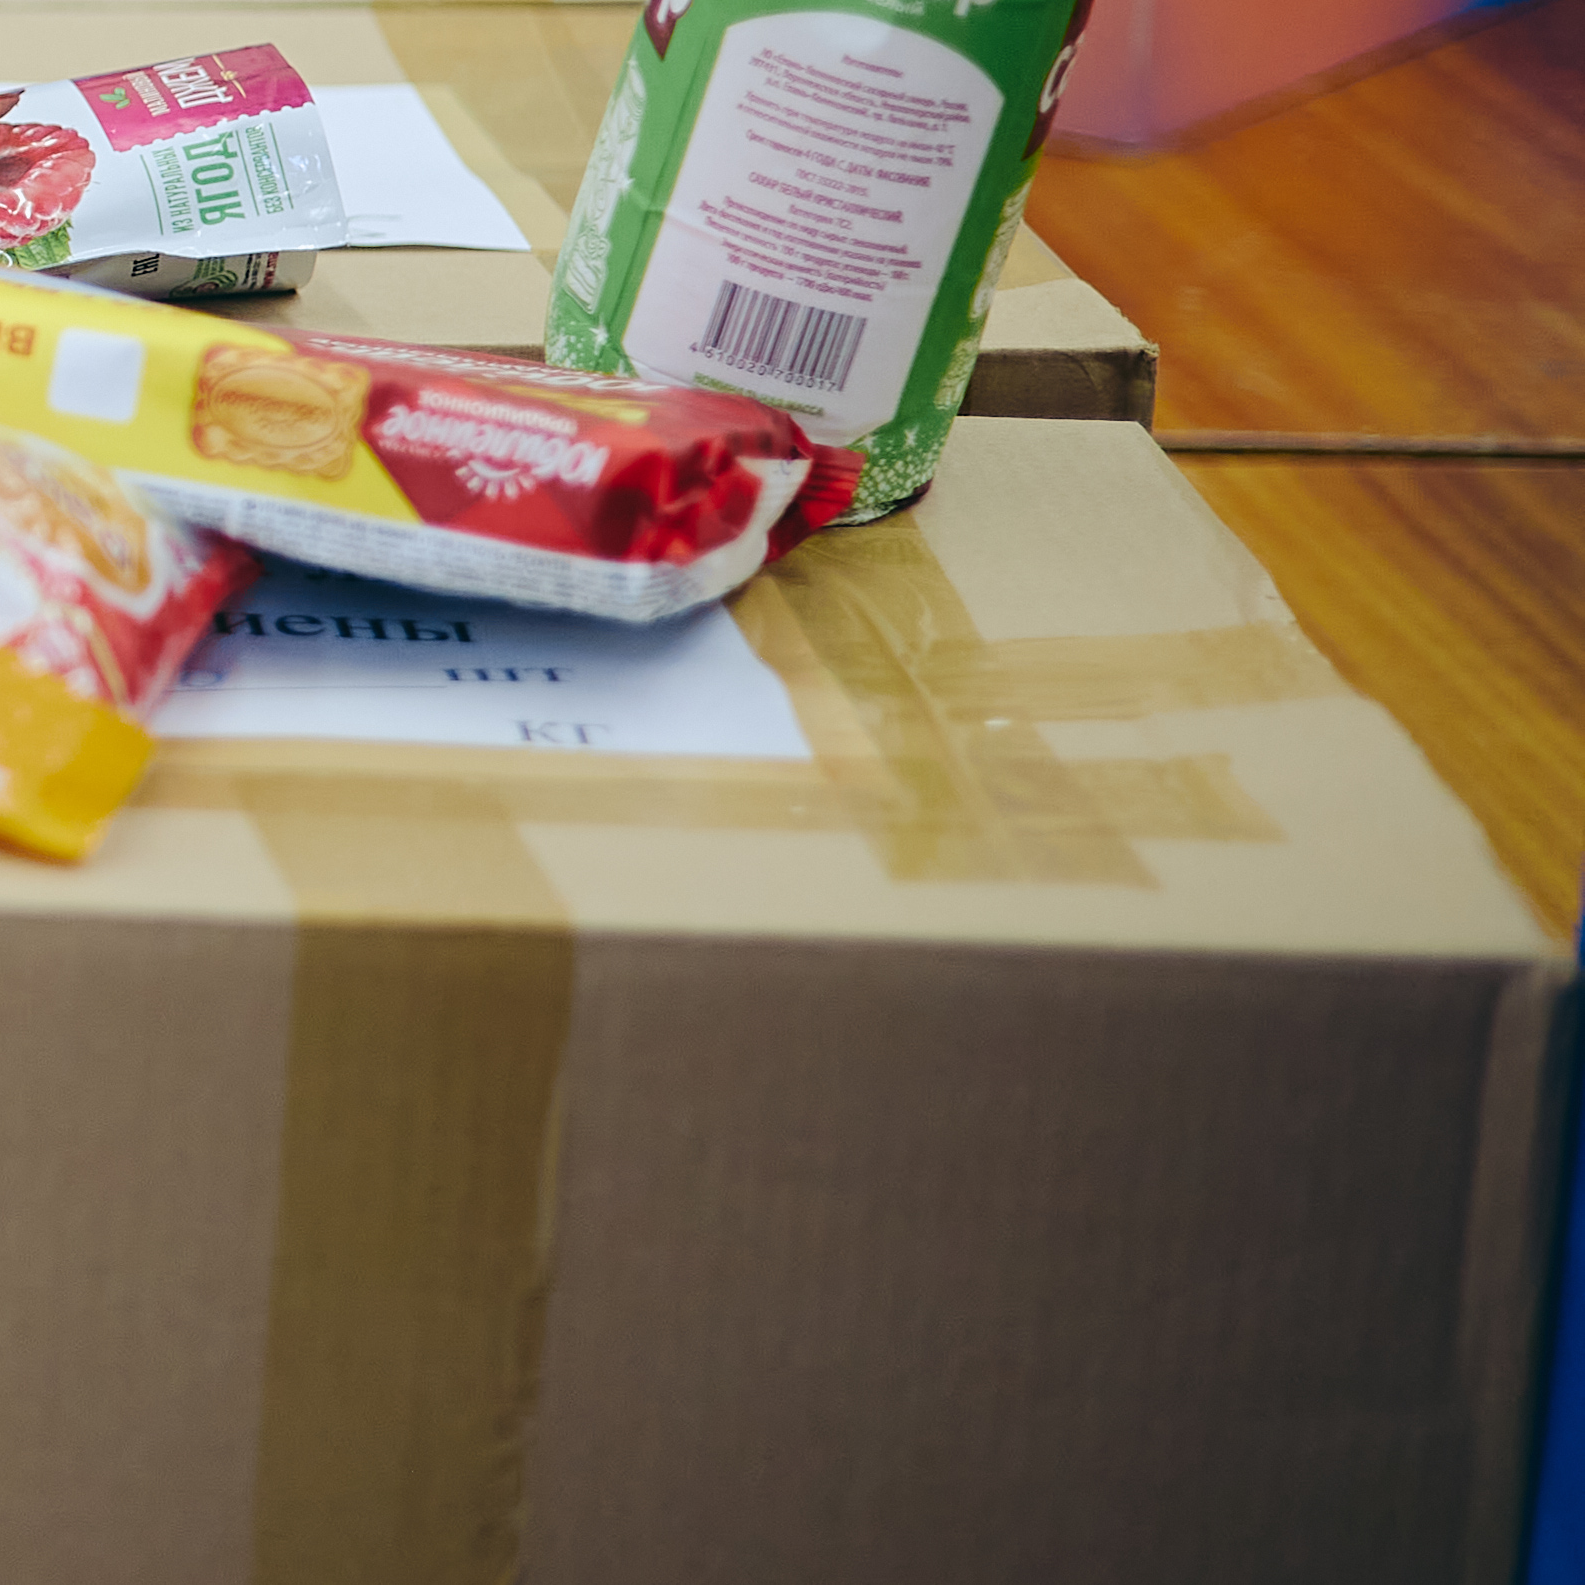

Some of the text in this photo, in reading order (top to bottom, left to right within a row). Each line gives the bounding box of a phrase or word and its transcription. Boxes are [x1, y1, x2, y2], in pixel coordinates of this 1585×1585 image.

[150, 145, 192, 221] НАТУРАЛЬНЫХ
[182, 131, 247, 226] ЯГОД
[264, 195, 285, 215] БЕЗ
[443, 666, 573, 683] шт
[514, 719, 610, 745] кг
